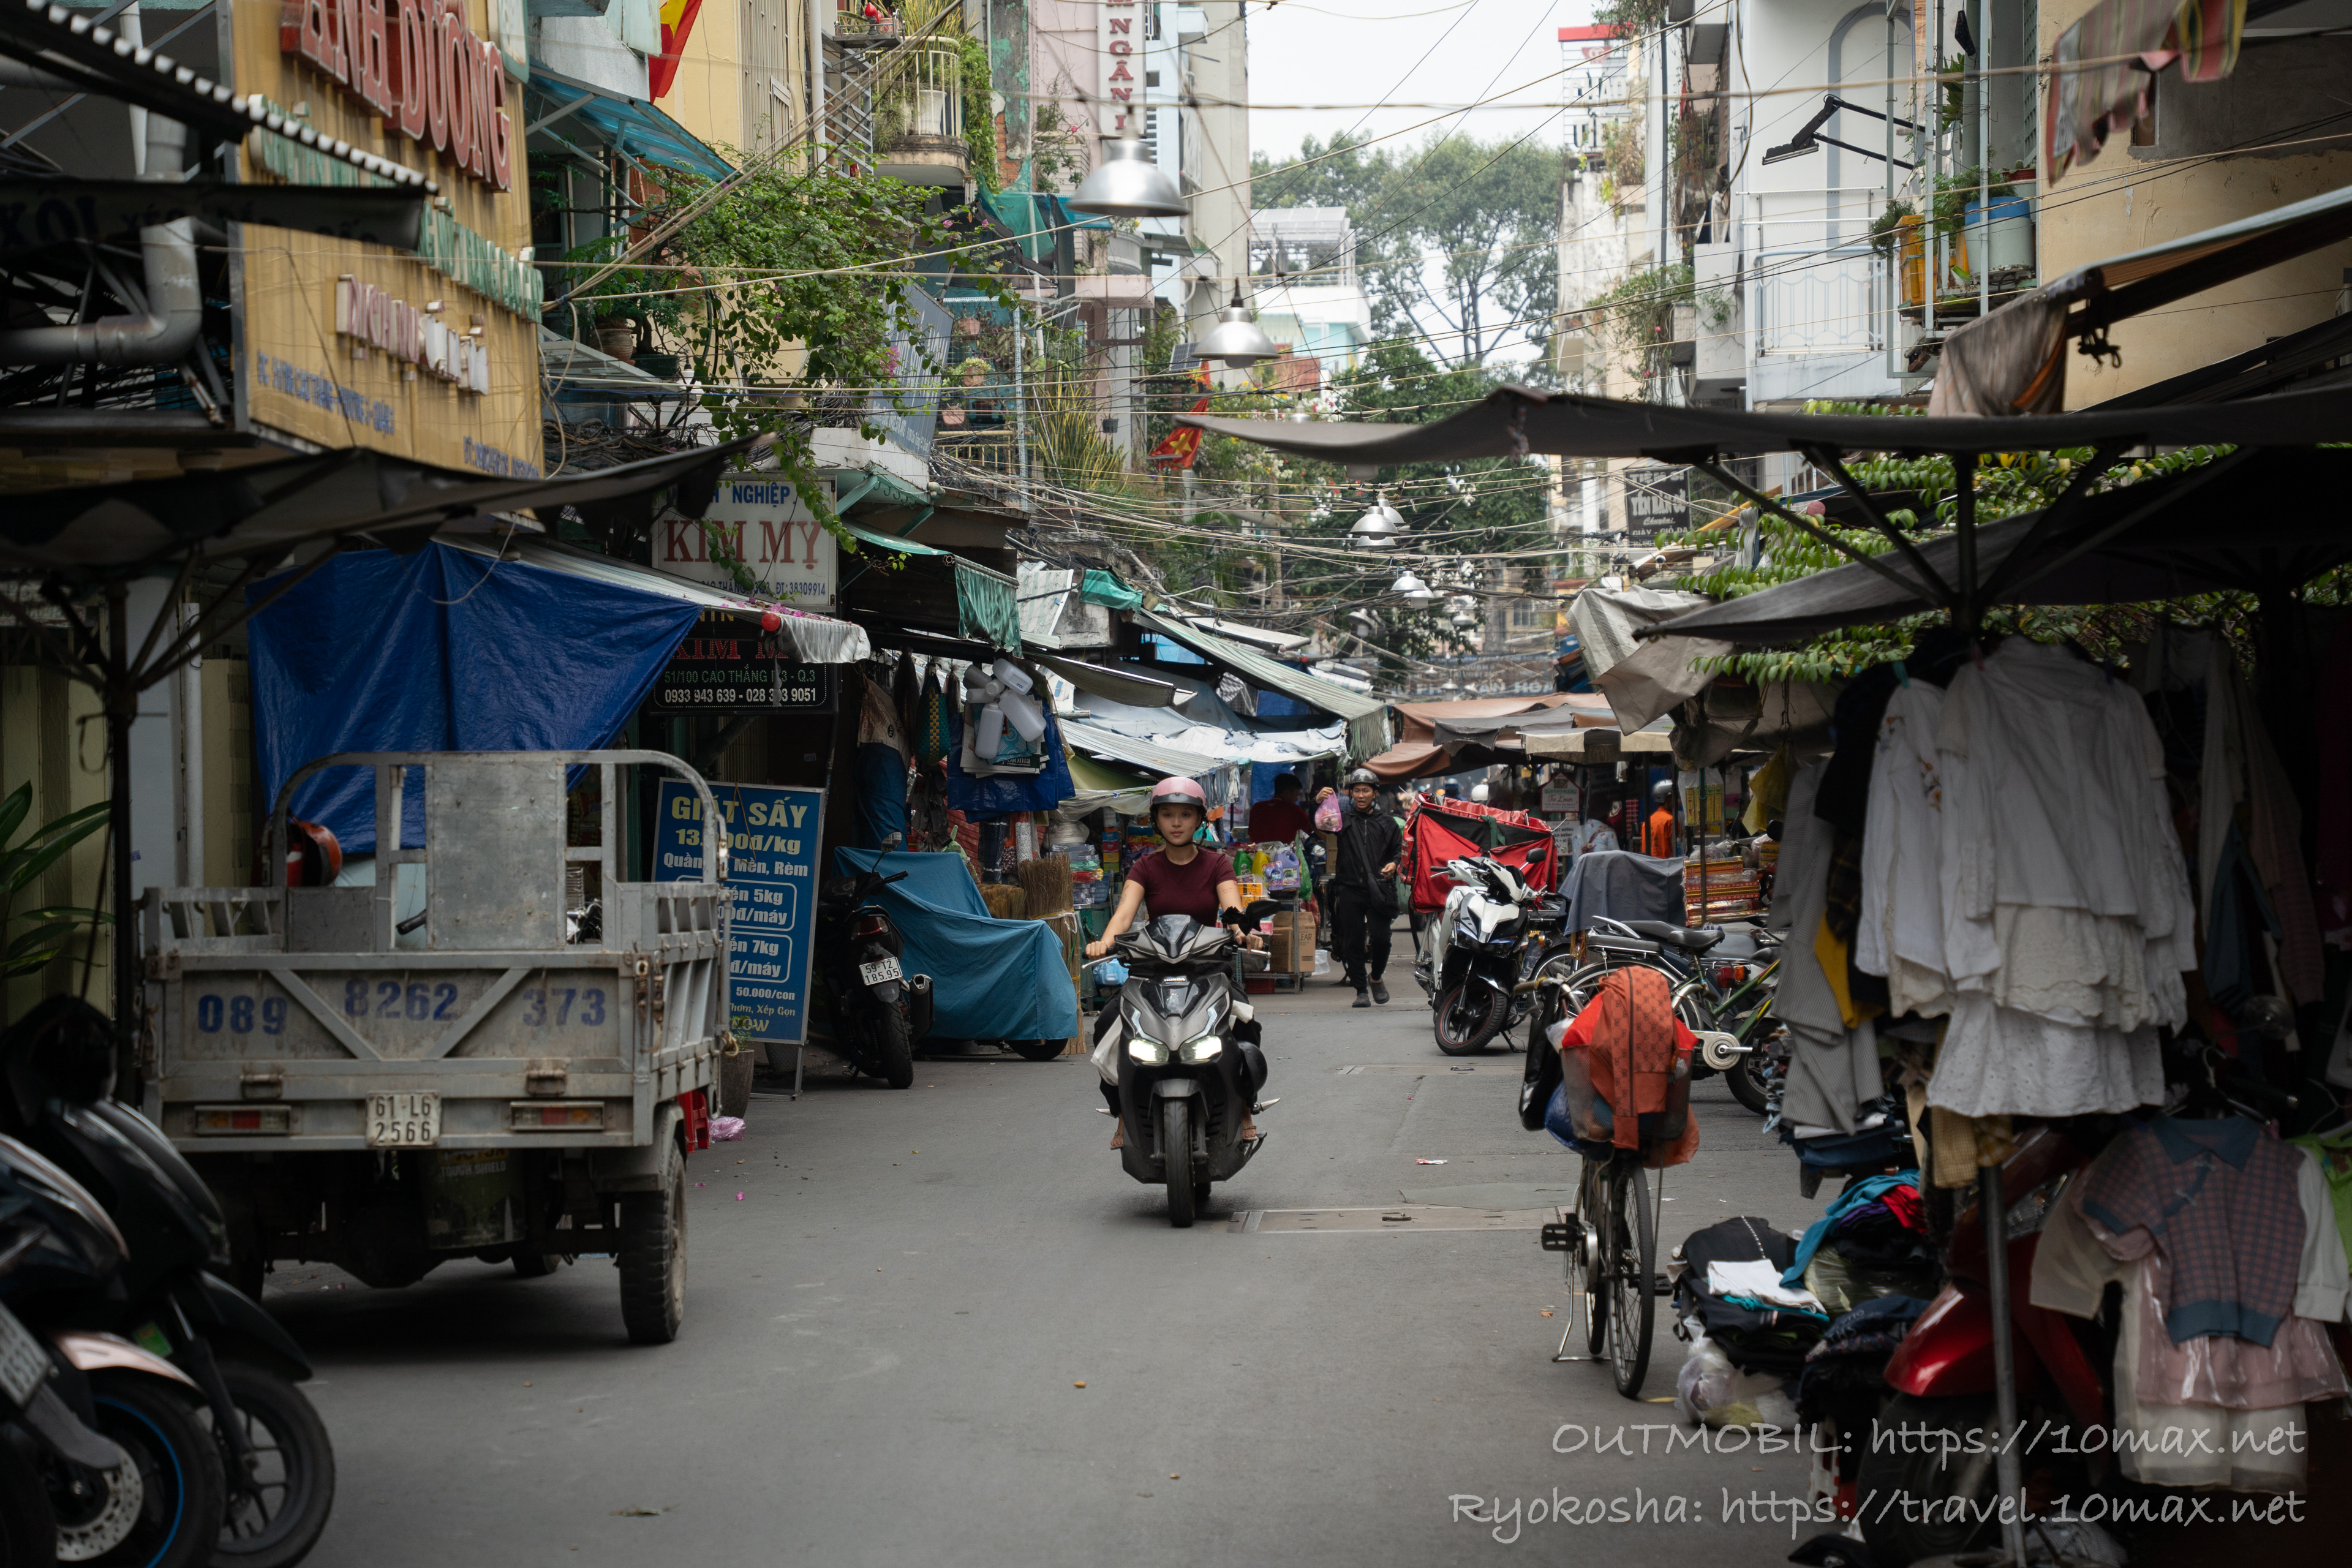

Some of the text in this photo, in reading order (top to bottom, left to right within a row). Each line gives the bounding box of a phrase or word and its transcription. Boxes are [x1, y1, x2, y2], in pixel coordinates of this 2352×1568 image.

[733, 482, 790, 507] NGHIỆP
[664, 520, 747, 562] KIM
[665, 671, 698, 684] 51/100
[702, 670, 725, 683] CAO
[728, 663, 767, 683] THẮNG
[797, 669, 816, 683] Q.3
[665, 689, 691, 703] 0933
[693, 689, 713, 703] 943
[716, 688, 736, 703] 639
[745, 688, 766, 703] 028
[791, 687, 816, 702] 9051
[748, 796, 808, 829] SẤY
[734, 858, 770, 875] Mền,
[774, 861, 808, 877] Rèm
[753, 889, 783, 905] 5kg
[752, 940, 779, 957] 7kg
[865, 960, 893, 974] 59-T2
[865, 968, 900, 983] 185.95
[344, 978, 458, 1020] 8262
[736, 987, 796, 1000] 50.000/con
[197, 993, 288, 1035] 089
[522, 987, 606, 1027] 373
[777, 1006, 796, 1017] Gọn
[376, 1121, 430, 1142] 2566
